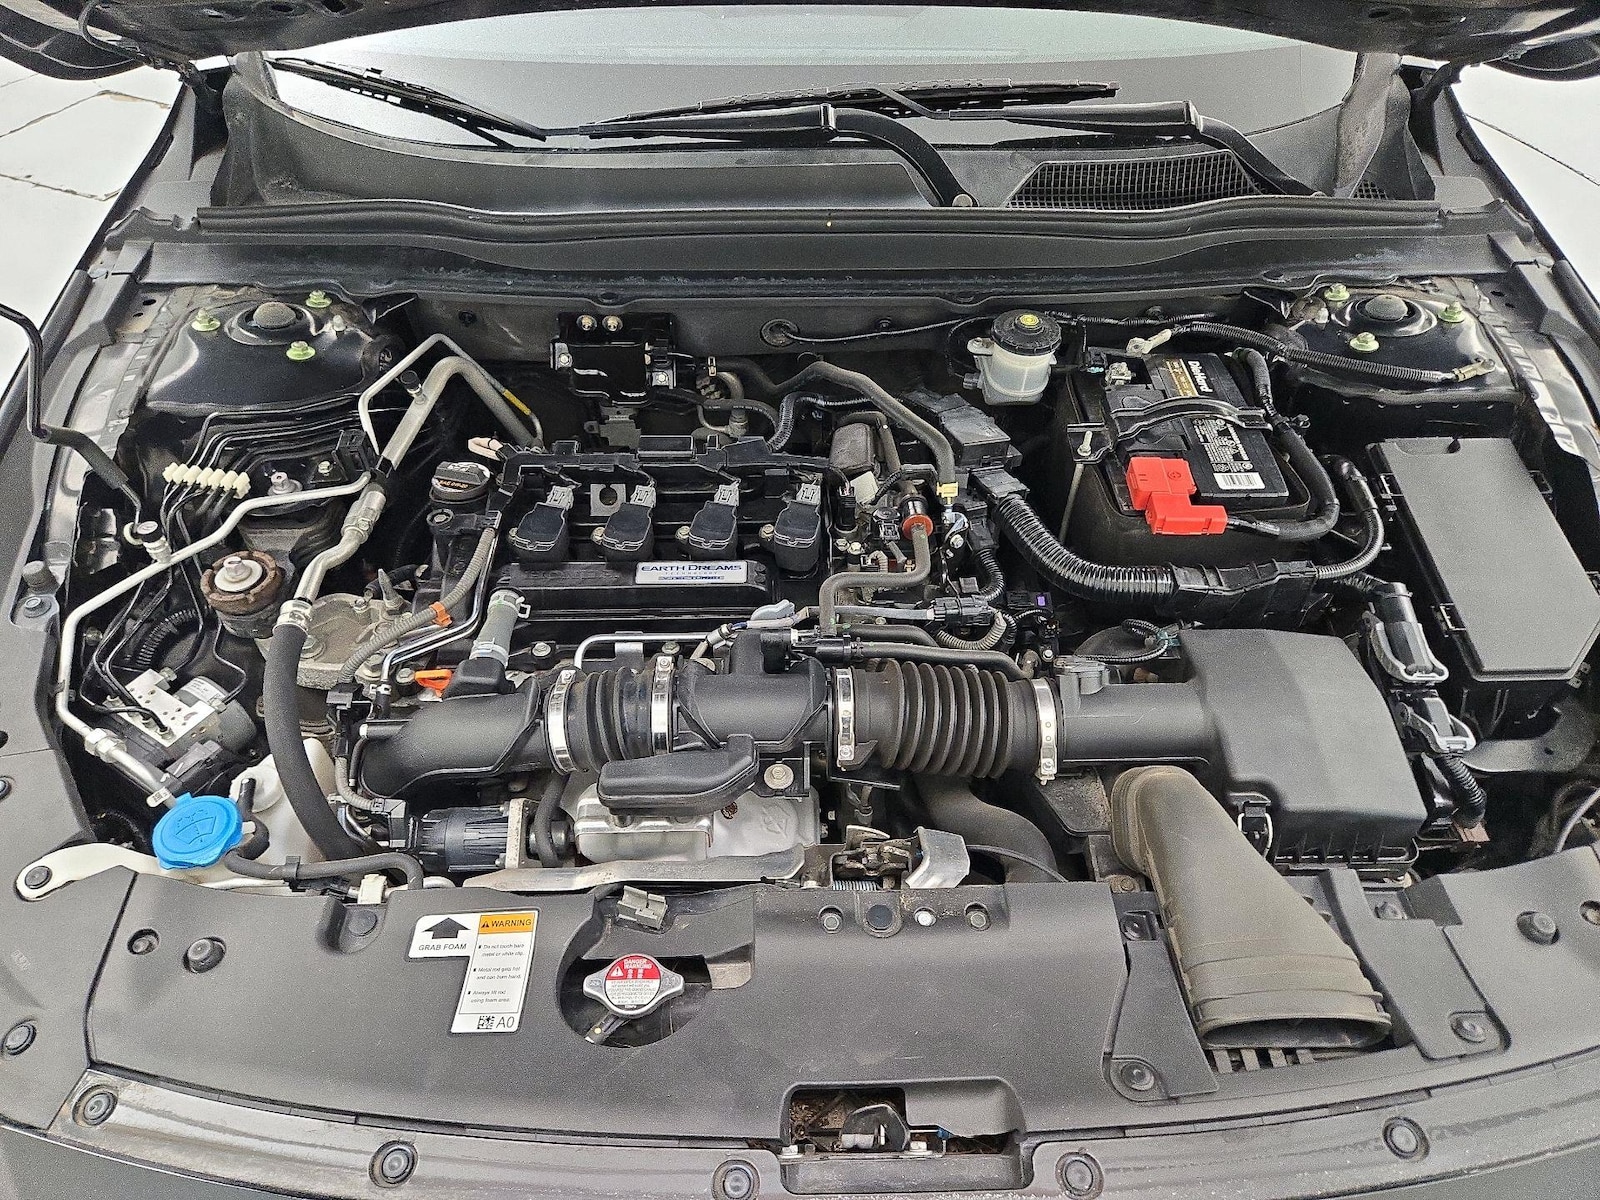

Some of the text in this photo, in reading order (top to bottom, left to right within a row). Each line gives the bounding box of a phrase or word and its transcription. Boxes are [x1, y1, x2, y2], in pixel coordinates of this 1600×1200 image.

[1188, 360, 1213, 393] DieHard
[688, 564, 742, 572] DREAMS
[491, 919, 532, 927] WARNING
[496, 1016, 515, 1029] A0
